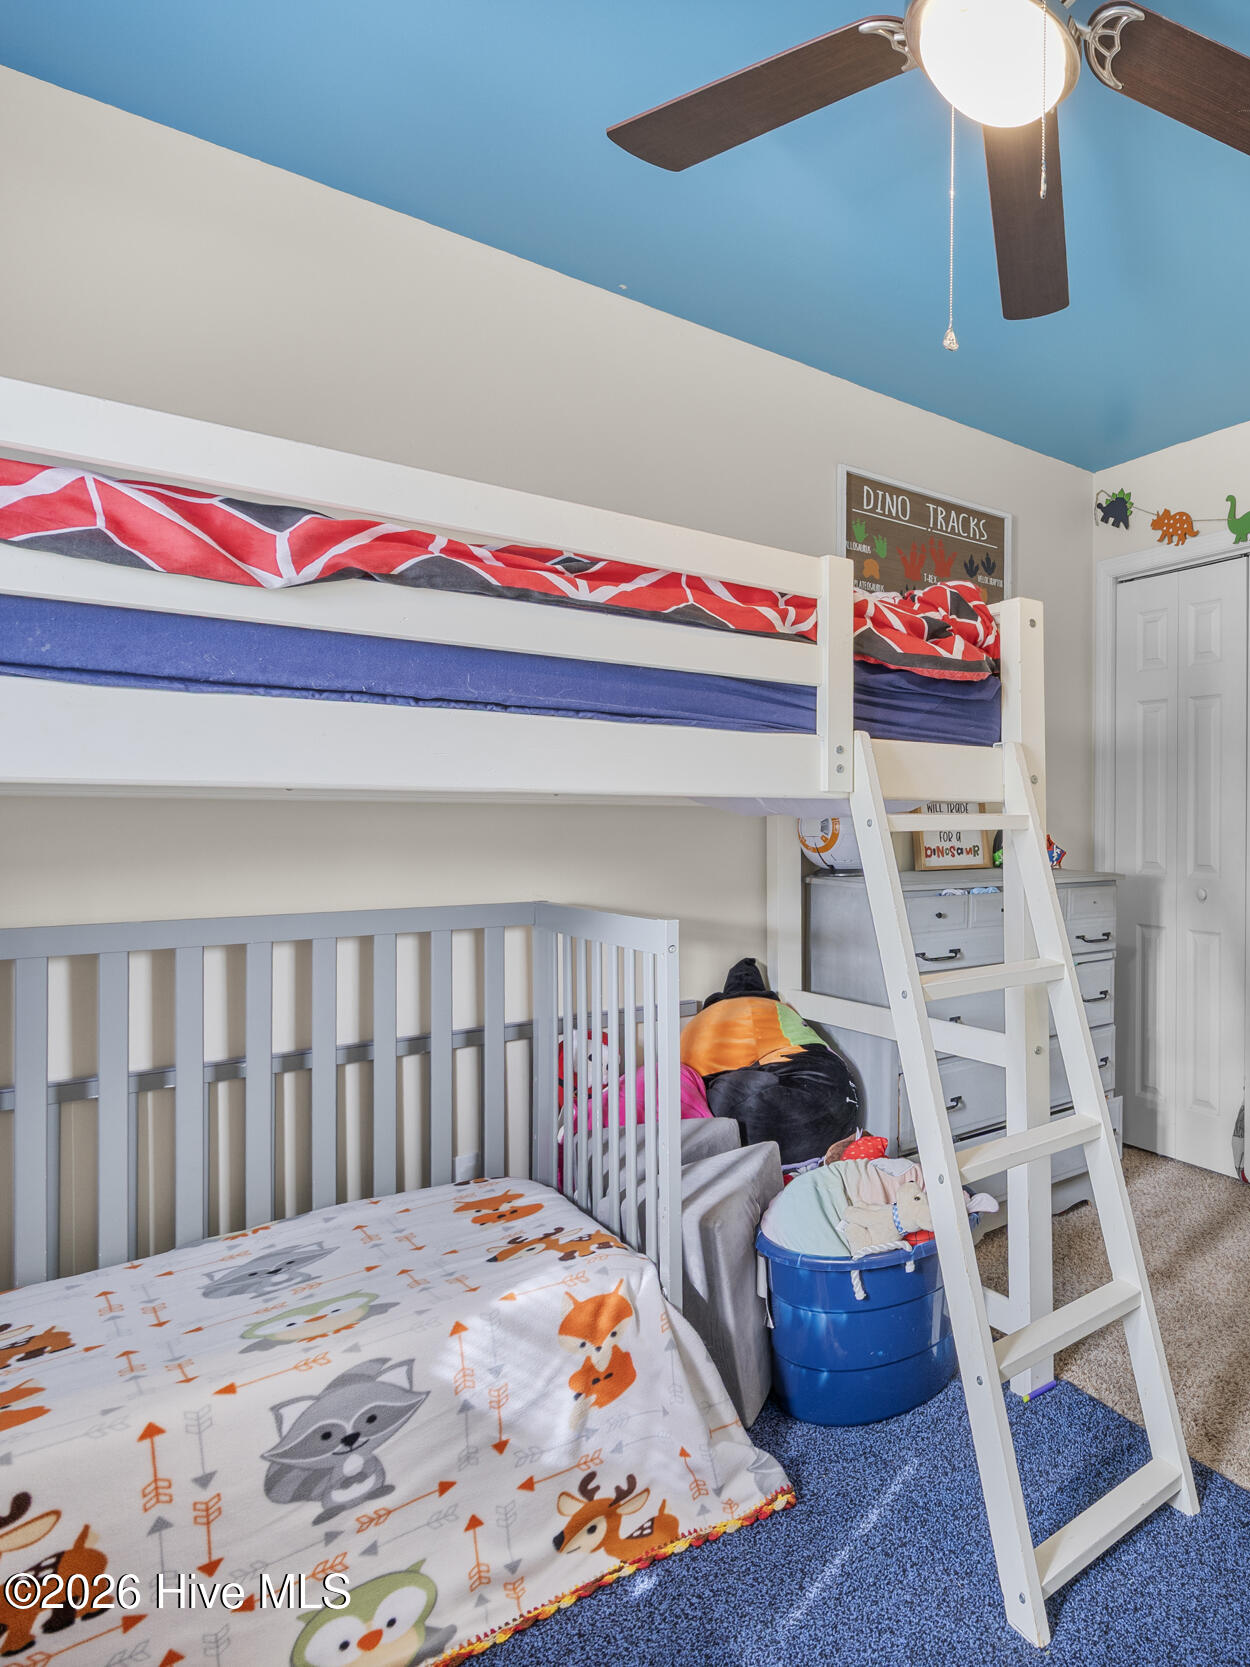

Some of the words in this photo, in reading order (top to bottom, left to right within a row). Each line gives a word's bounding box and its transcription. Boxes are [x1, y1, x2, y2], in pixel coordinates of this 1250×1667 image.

[863, 485, 911, 521] DINO
[925, 503, 988, 541] TRACKS
[926, 803, 944, 814] WILL
[939, 831, 953, 842] FOR
